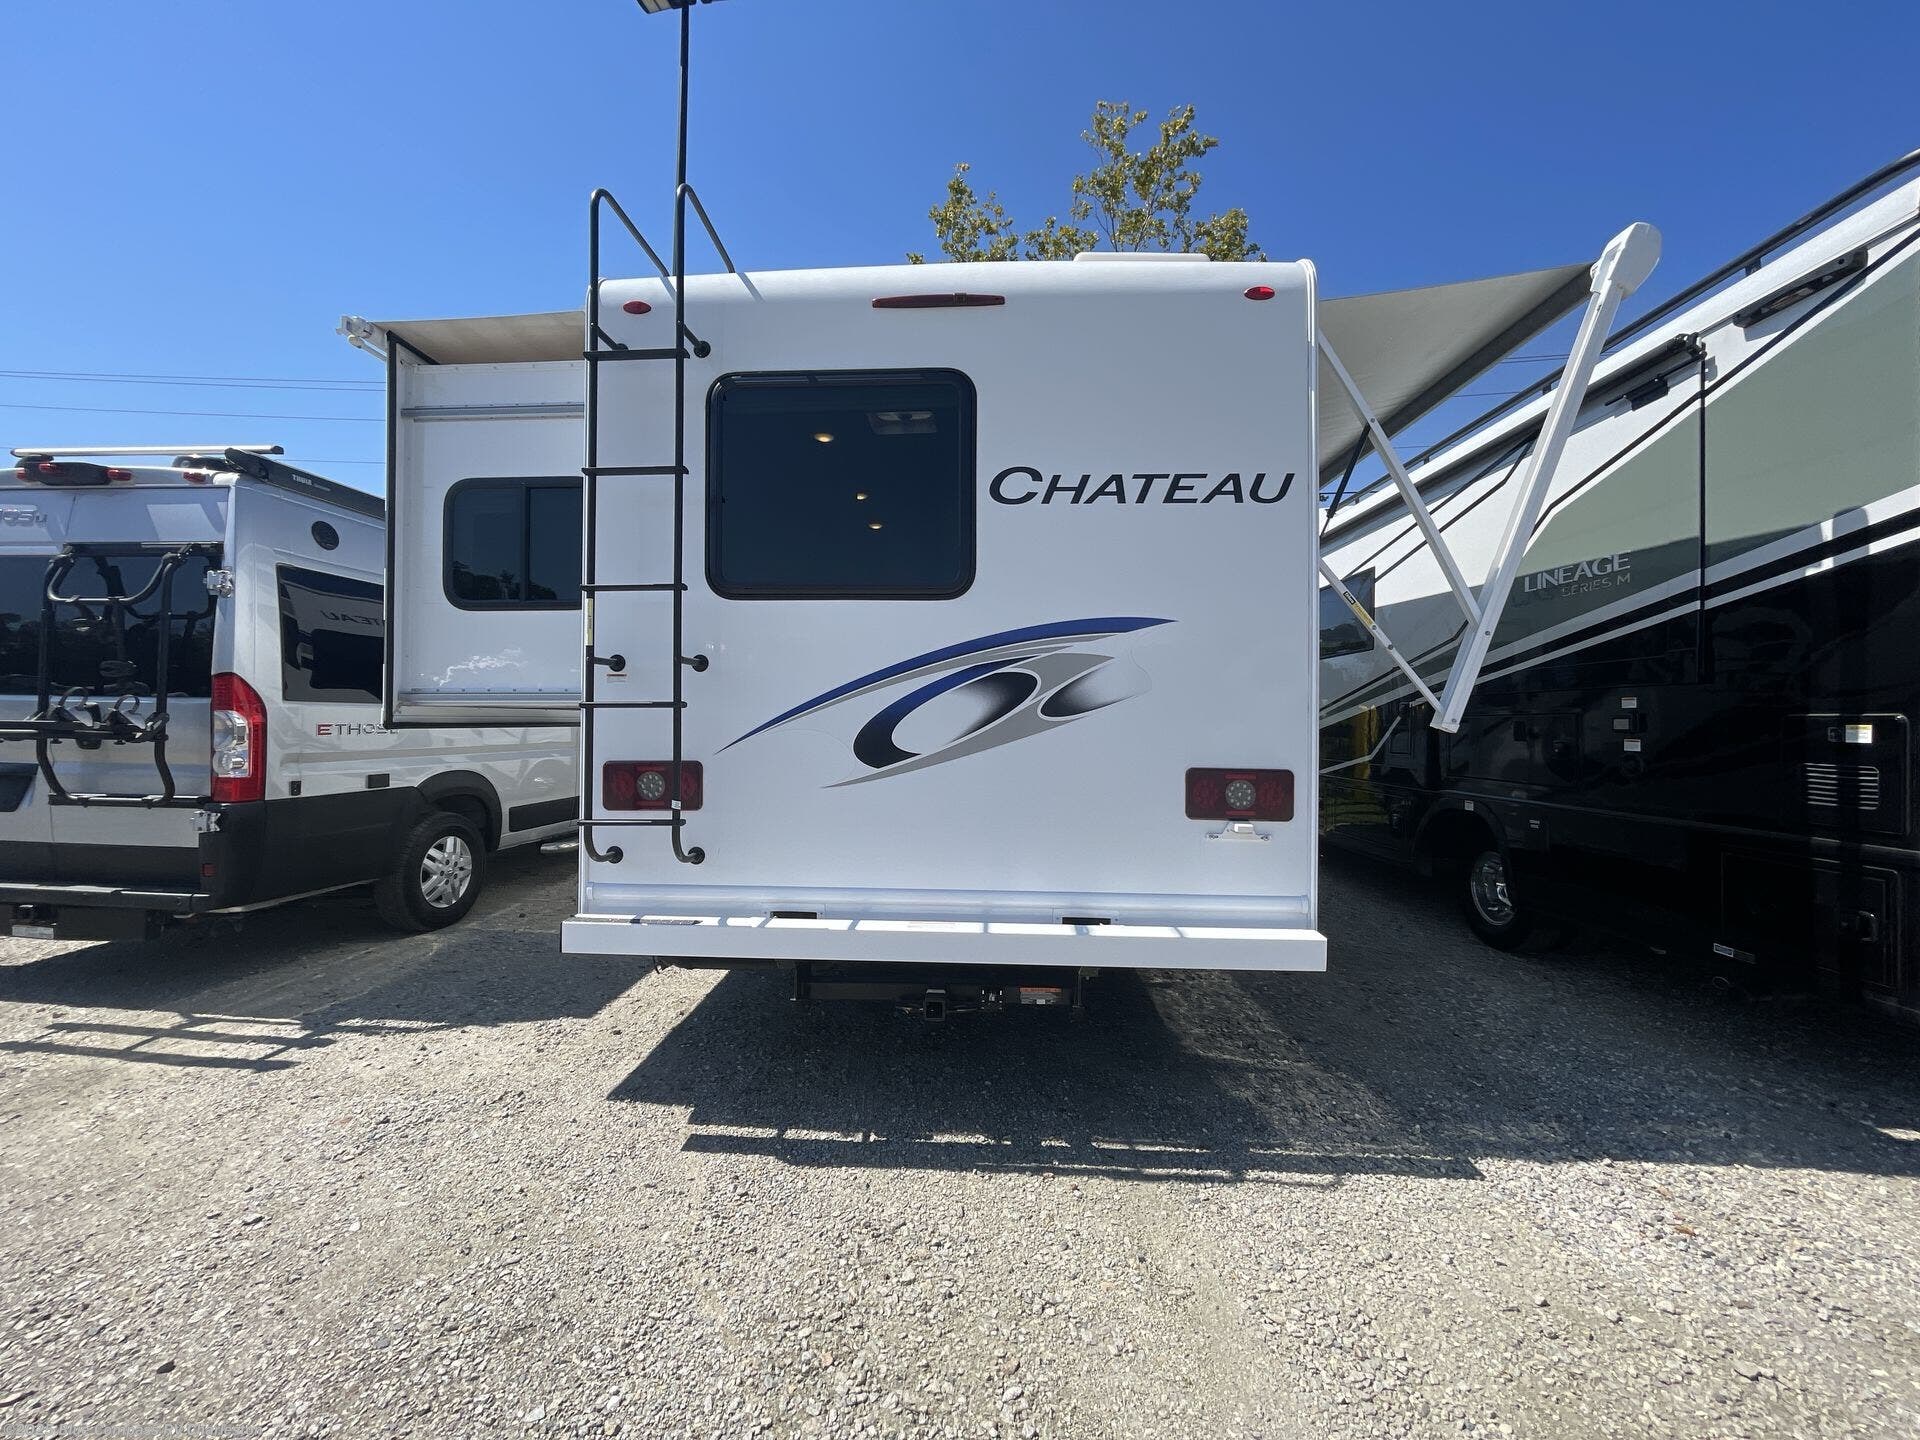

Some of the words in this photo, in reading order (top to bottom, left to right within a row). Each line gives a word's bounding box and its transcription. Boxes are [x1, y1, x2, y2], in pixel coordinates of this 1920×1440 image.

[988, 466, 1295, 505] CHATEAU
[1524, 550, 1631, 593] LINEAGE
[1561, 577, 1613, 597] SERIES
[1617, 573, 1631, 586] M
